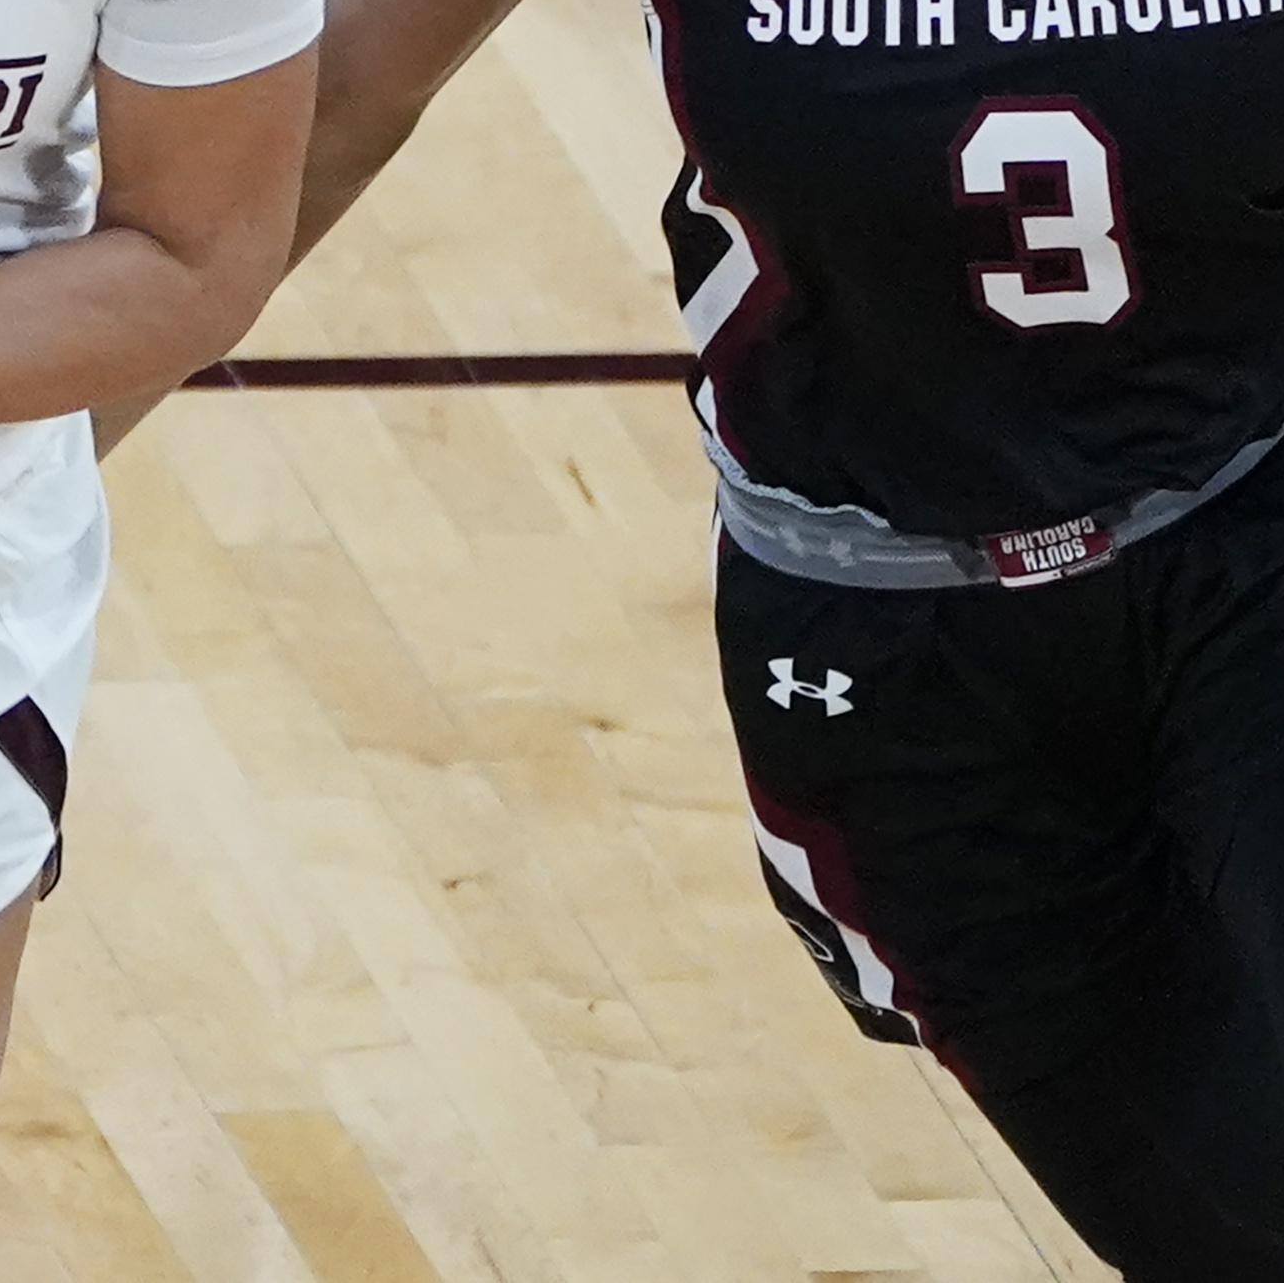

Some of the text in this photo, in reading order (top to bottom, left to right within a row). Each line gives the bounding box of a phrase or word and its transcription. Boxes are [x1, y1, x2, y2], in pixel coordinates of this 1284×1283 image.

[957, 108, 1133, 330] 3
[999, 515, 1097, 556] CAROLINA
[1021, 536, 1087, 573] SOUTH
